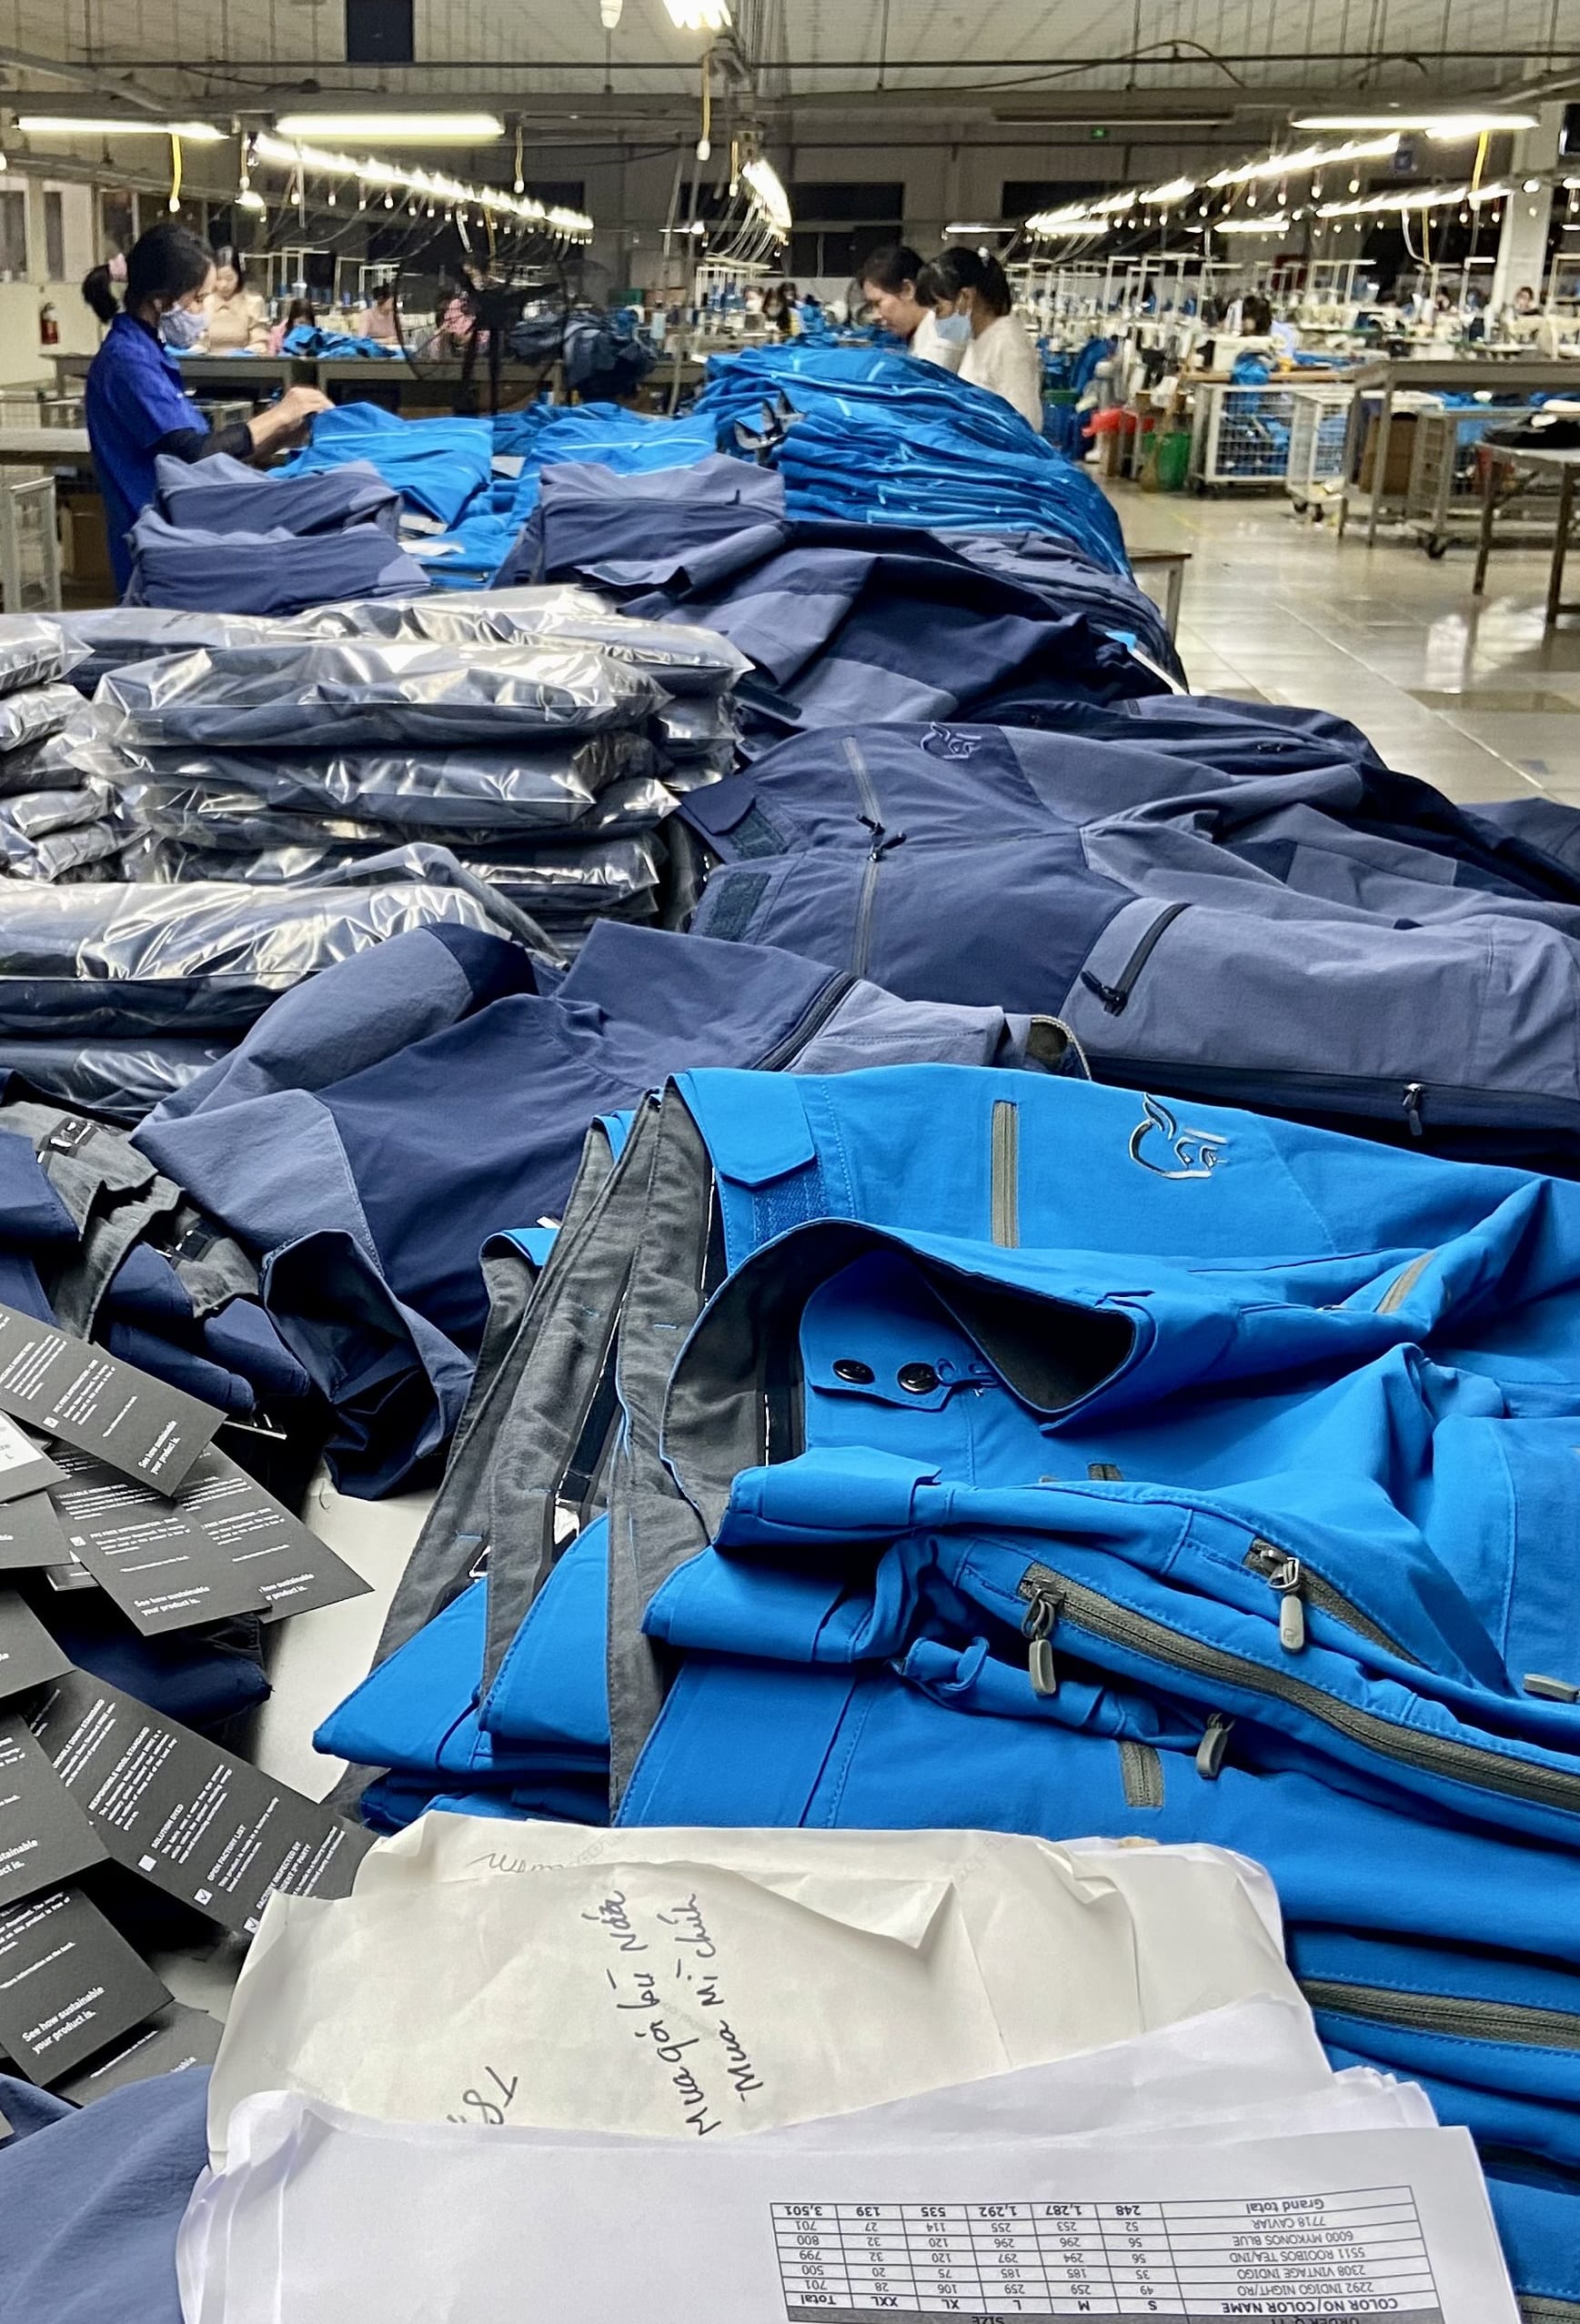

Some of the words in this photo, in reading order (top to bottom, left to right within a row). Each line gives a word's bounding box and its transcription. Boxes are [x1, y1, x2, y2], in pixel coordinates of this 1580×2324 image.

[137, 1456, 150, 1468] See
[145, 1445, 157, 1458] how
[149, 1460, 162, 1474] your
[158, 1442, 176, 1464] product
[151, 1818, 173, 1848] SOLUTION
[291, 1841, 301, 1851] BY
[206, 1863, 221, 1881] OPEN
[217, 1837, 236, 1864] FACTORY
[233, 1824, 246, 1838] LIST
[22, 2027, 41, 2042] See
[38, 2016, 58, 2030] how
[57, 1987, 104, 2018] sustainable
[32, 2036, 52, 2054] your
[52, 2015, 85, 2041] product
[81, 2010, 96, 2019] is.
[783, 2205, 823, 2217] 3,501
[978, 2205, 1018, 2218] 1,292
[1045, 2205, 1082, 2217] 1,287
[1114, 2205, 1142, 2216] 248
[1245, 2201, 1279, 2215] total
[1282, 2198, 1324, 2213] Grand
[855, 2206, 881, 2218] 139
[921, 2206, 947, 2218] 535
[795, 2219, 818, 2231] 701
[864, 2221, 879, 2232] 27
[926, 2222, 946, 2232] 114
[991, 2222, 1011, 2233] 255
[1056, 2221, 1078, 2232] 253
[1124, 2221, 1139, 2232] 52
[1251, 2218, 1295, 2229] CAVIAR
[1297, 2216, 1326, 2228] 7718
[797, 2234, 820, 2247] 800
[866, 2236, 881, 2247] 32
[1232, 2235, 1263, 2247] BLUE
[1264, 2233, 1323, 2246] MYKONOS
[1324, 2230, 1354, 2243] 6000
[928, 2238, 949, 2249] 120
[993, 2238, 1015, 2249] 296
[1059, 2237, 1082, 2249] 296
[1128, 2237, 1142, 2249] 56
[799, 2249, 822, 2261] 799
[868, 2251, 884, 2262] 32
[931, 2252, 951, 2263] 120
[998, 2253, 1019, 2264] 297
[1062, 2252, 1084, 2263] 294
[1132, 2253, 1147, 2264] 56
[1228, 2250, 1279, 2263] TEA/IND
[1280, 2249, 1334, 2262] ROOIBOS
[1337, 2247, 1366, 2259] 5511
[800, 2265, 824, 2276] 500
[871, 2267, 886, 2278] 20
[937, 2269, 953, 2279] 75
[1001, 2269, 1021, 2279] 185
[1066, 2269, 1087, 2279] 185
[1135, 2269, 1151, 2280] 35
[1236, 2268, 1281, 2280] INDIGO
[1283, 2267, 1335, 2279] VINTAGE
[1337, 2264, 1366, 2277] 2308
[804, 2279, 828, 2290] 701
[873, 2281, 890, 2292] 28
[937, 2283, 958, 2294] 106
[1004, 2283, 1026, 2295] 259
[1070, 2283, 1092, 2296] 259
[1140, 2285, 1154, 2296] 49
[1237, 2284, 1296, 2297] NIGHT/RO
[1298, 2283, 1344, 2296] INDIGO
[1344, 2281, 1374, 2294] 2292
[800, 2294, 837, 2306] Total
[870, 2296, 899, 2308] XXL
[941, 2298, 961, 2310] XL
[1011, 2299, 1022, 2310] L
[1077, 2299, 1091, 2311] M
[1147, 2299, 1158, 2311] S
[1265, 2299, 1345, 2313] NO/COLOR
[1347, 2298, 1399, 2311] COLOR
[1221, 2302, 1263, 2314] NAME
